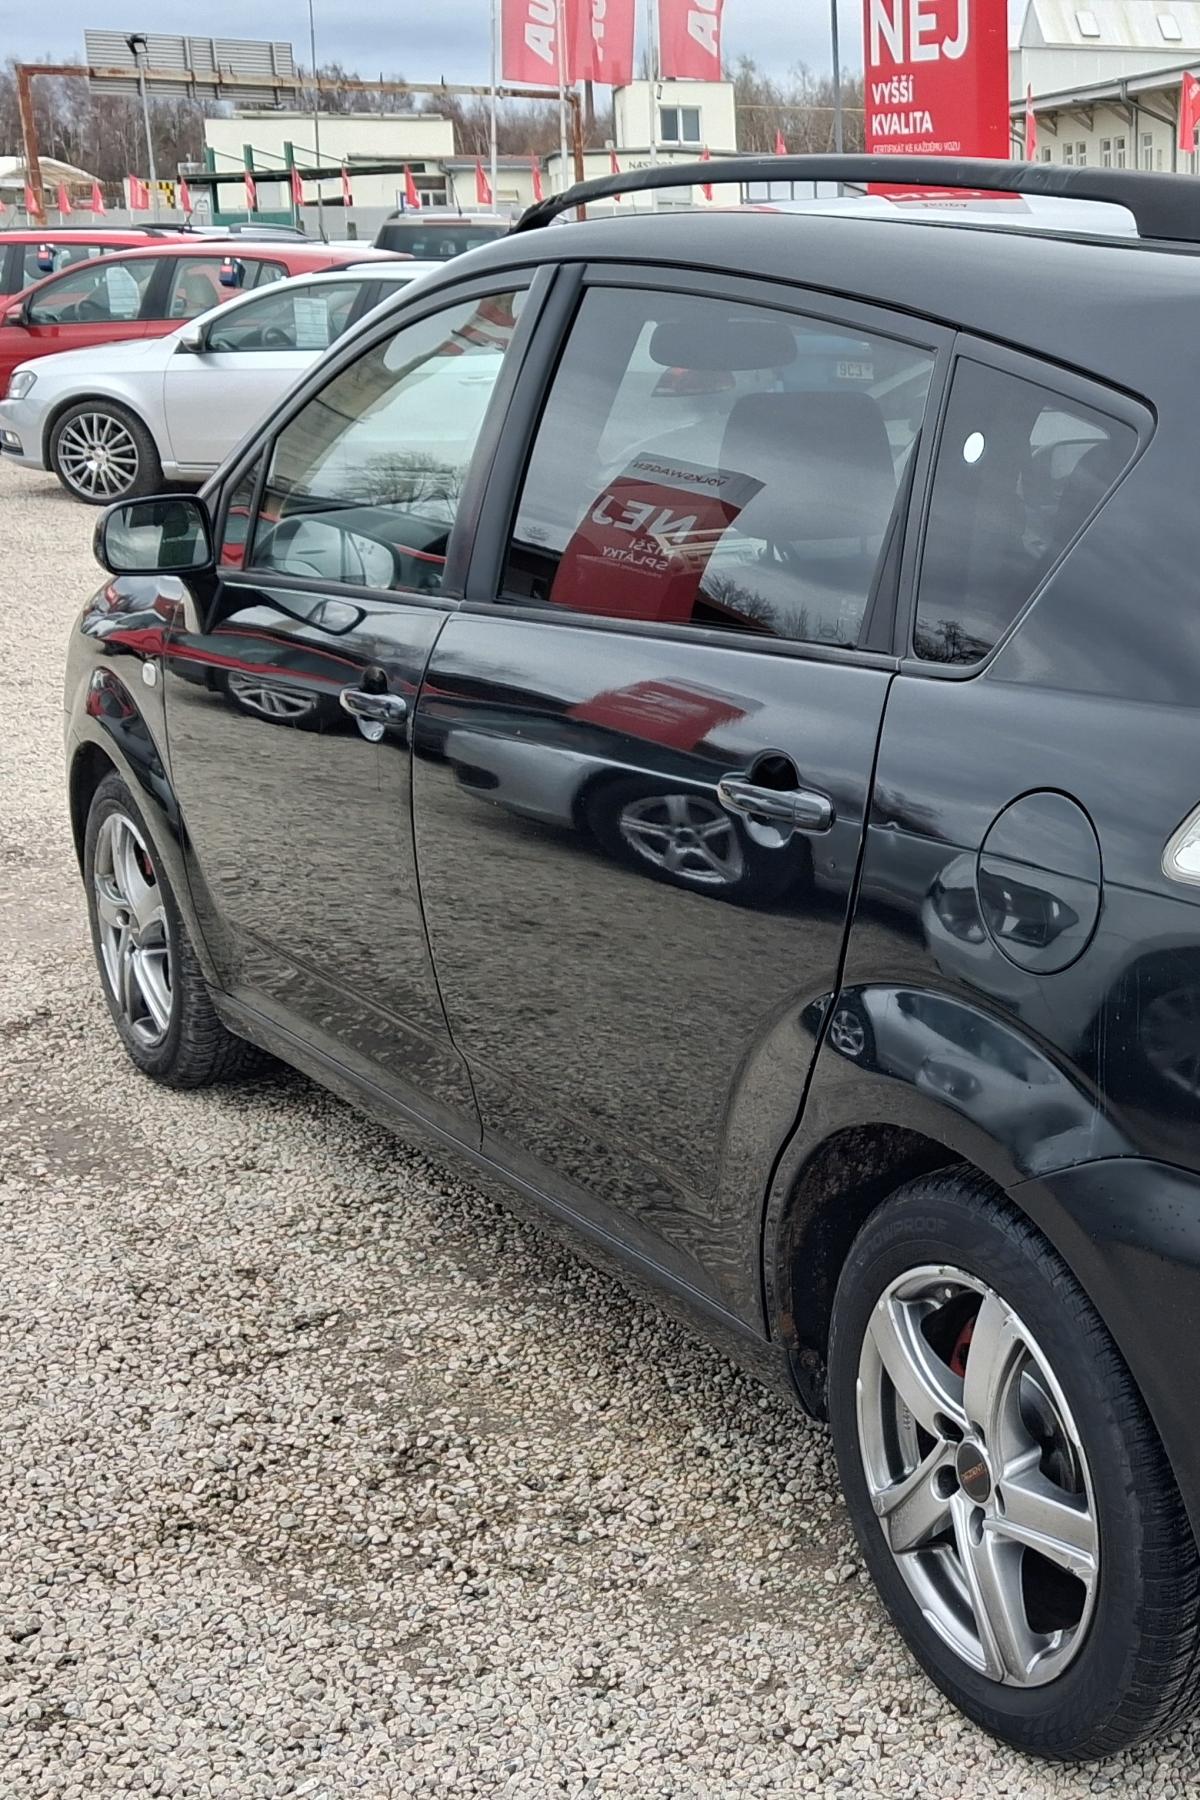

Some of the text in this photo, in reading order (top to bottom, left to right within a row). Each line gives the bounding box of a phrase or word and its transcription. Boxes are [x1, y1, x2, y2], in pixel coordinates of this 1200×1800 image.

[870, 0, 969, 67] NEJ
[872, 75, 914, 105] VYŠŠÍ
[872, 111, 934, 137] KVALITA
